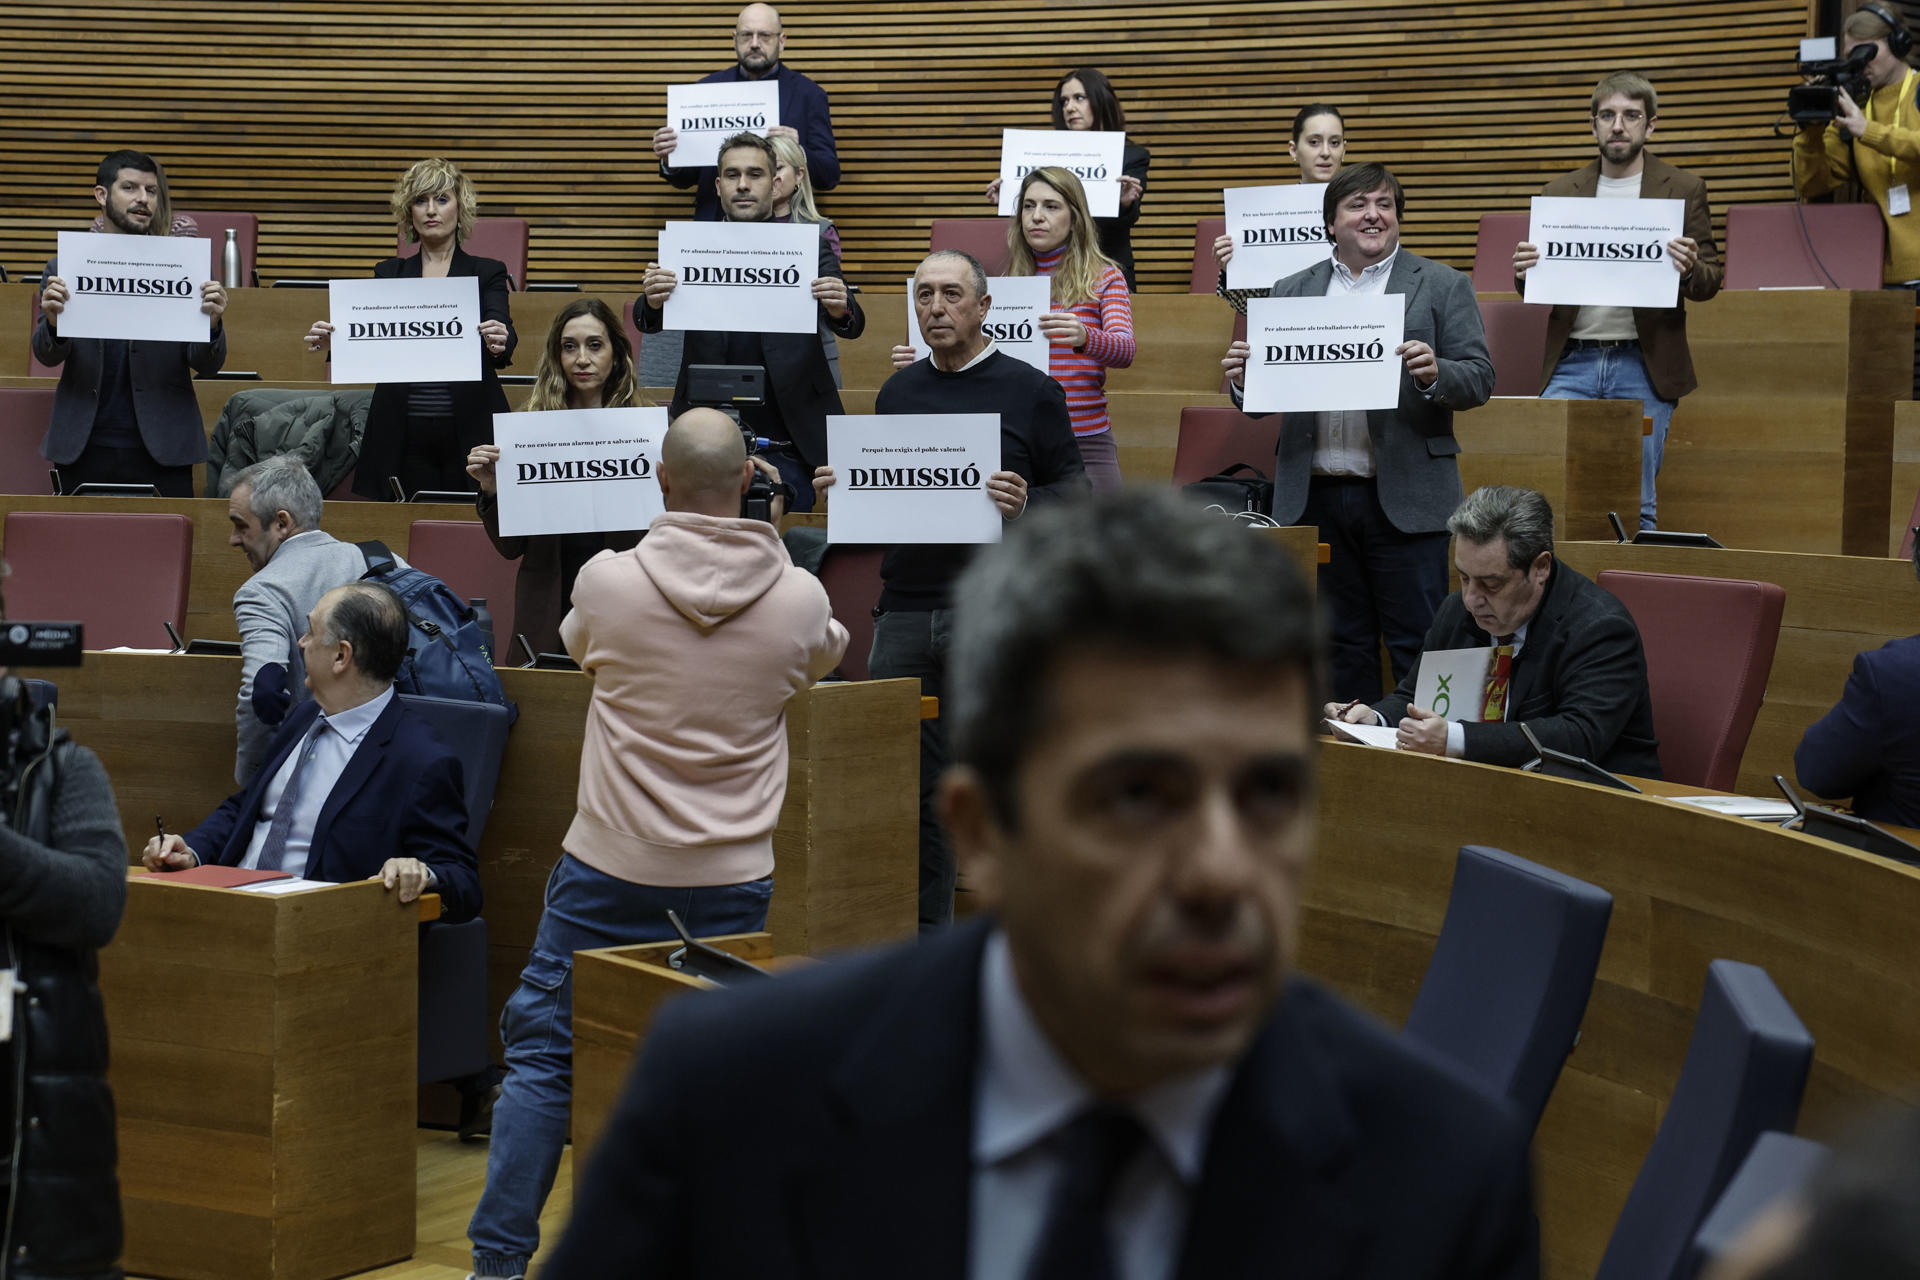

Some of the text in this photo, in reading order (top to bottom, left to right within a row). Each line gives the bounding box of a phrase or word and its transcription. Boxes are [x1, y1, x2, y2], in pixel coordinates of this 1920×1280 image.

[680, 112, 766, 130] DIMISSIÓ
[1546, 240, 1663, 260] DIMISSIÓ
[682, 264, 800, 285] DIMISSIÓ
[76, 276, 192, 296] DIMISSIÓ
[348, 316, 463, 338] DIMISSIÓ
[1264, 337, 1384, 362] DIMISSIÓ
[516, 453, 650, 481] DIMISSIÓ
[848, 462, 980, 487] DIMISSIÓ
[1432, 673, 1453, 718] OX
